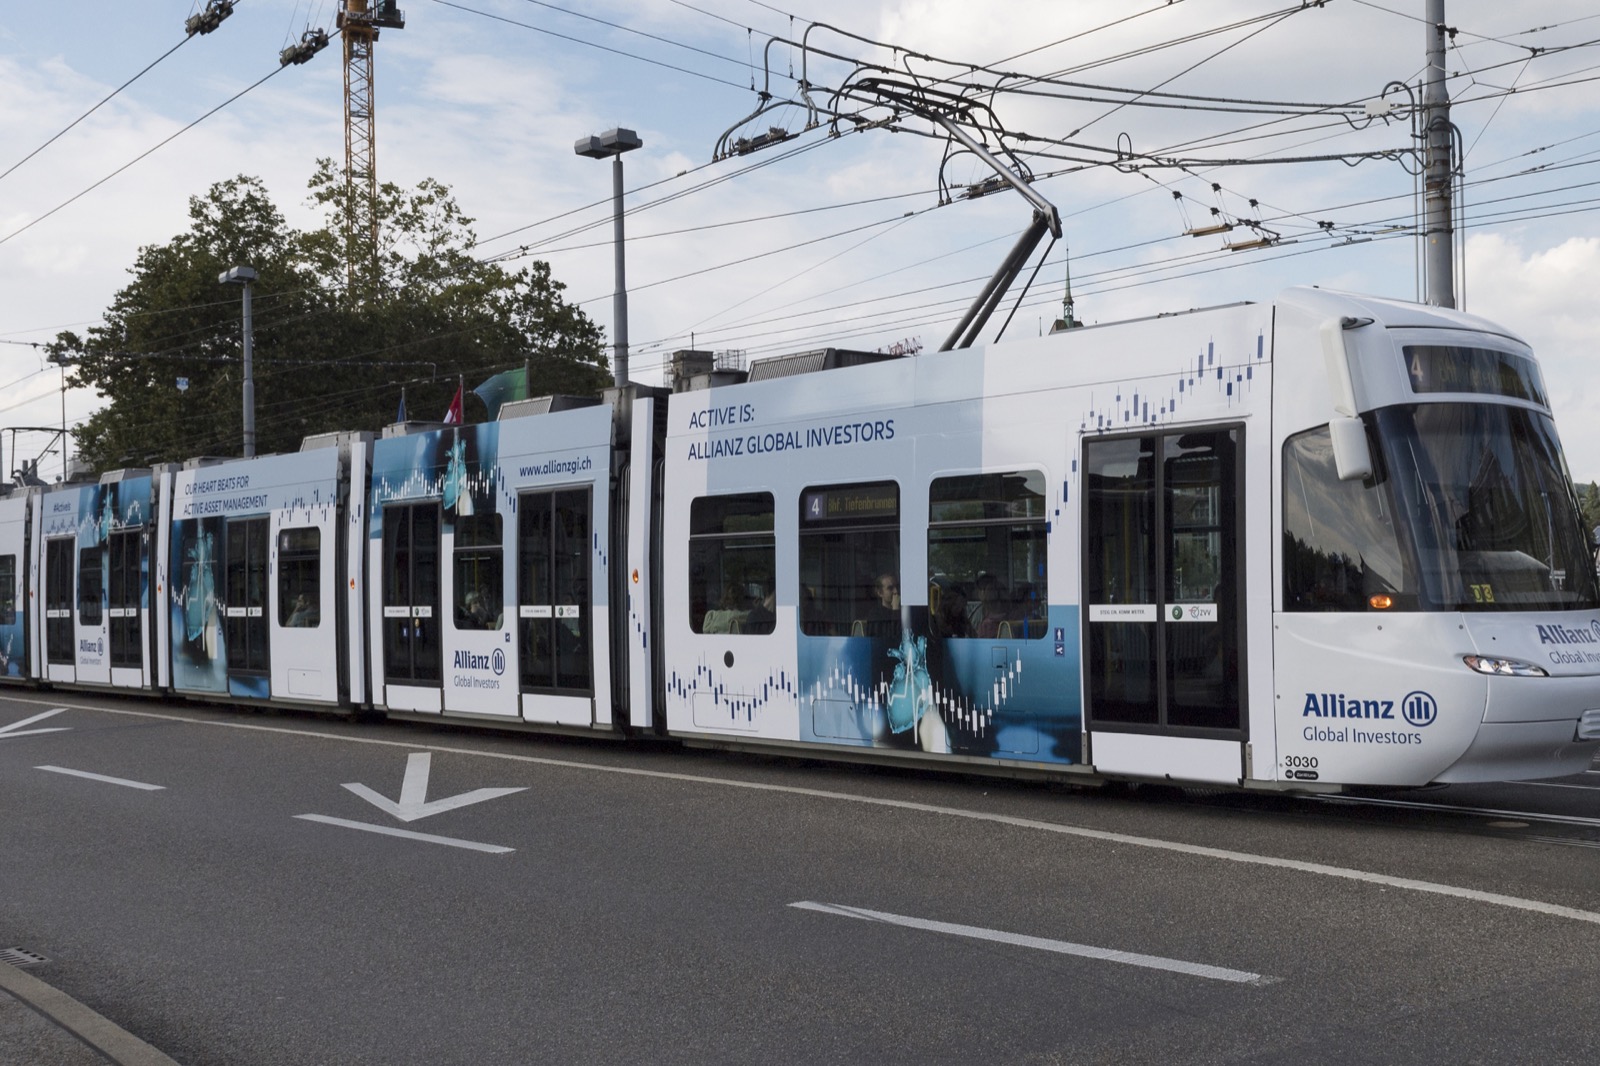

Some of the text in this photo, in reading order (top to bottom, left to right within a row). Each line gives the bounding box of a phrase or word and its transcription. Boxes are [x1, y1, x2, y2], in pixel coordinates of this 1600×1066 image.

[1410, 353, 1424, 382] 4
[689, 403, 755, 429] ACTIVE IS:
[688, 419, 895, 460] ALLIANZ GLOBAL INVESTORS
[519, 455, 592, 477] www.allianzgi.ch
[185, 475, 250, 495] OUR HEART BEATS FOR
[184, 494, 268, 515] ACTIVE ASSET MANAGEMENT
[811, 499, 820, 515] 4
[1535, 624, 1598, 645] Allianz
[453, 650, 490, 670] Allianz
[1549, 650, 1586, 664] Global
[454, 675, 500, 690] Global Investors
[1302, 693, 1395, 719] Allianz
[1303, 726, 1422, 744] Global Investors
[1285, 756, 1319, 769] 3030
